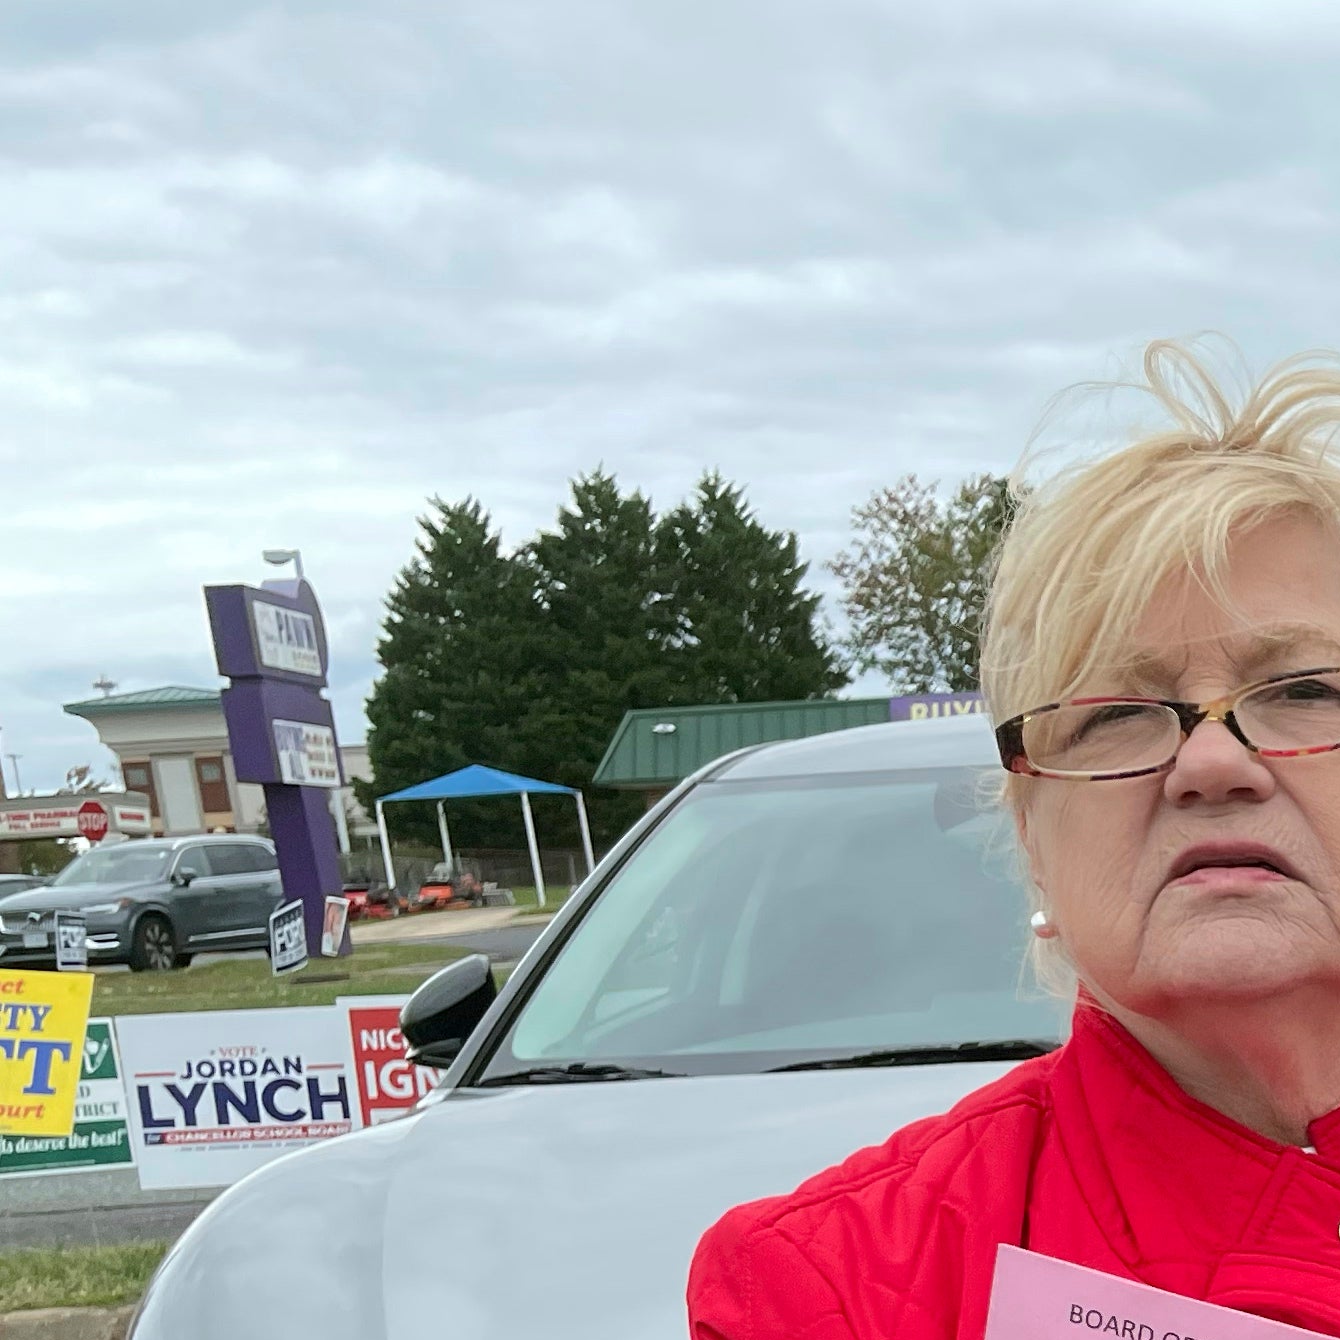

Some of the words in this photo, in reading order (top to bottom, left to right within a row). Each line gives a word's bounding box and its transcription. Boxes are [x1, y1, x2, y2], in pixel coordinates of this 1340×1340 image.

[80, 814, 107, 831] STOP
[219, 1046, 257, 1057] VOTE
[180, 1056, 302, 1079] JORDAN
[137, 1076, 350, 1128] LYNCH
[0, 1104, 44, 1119] ourt
[68, 1131, 88, 1149] the
